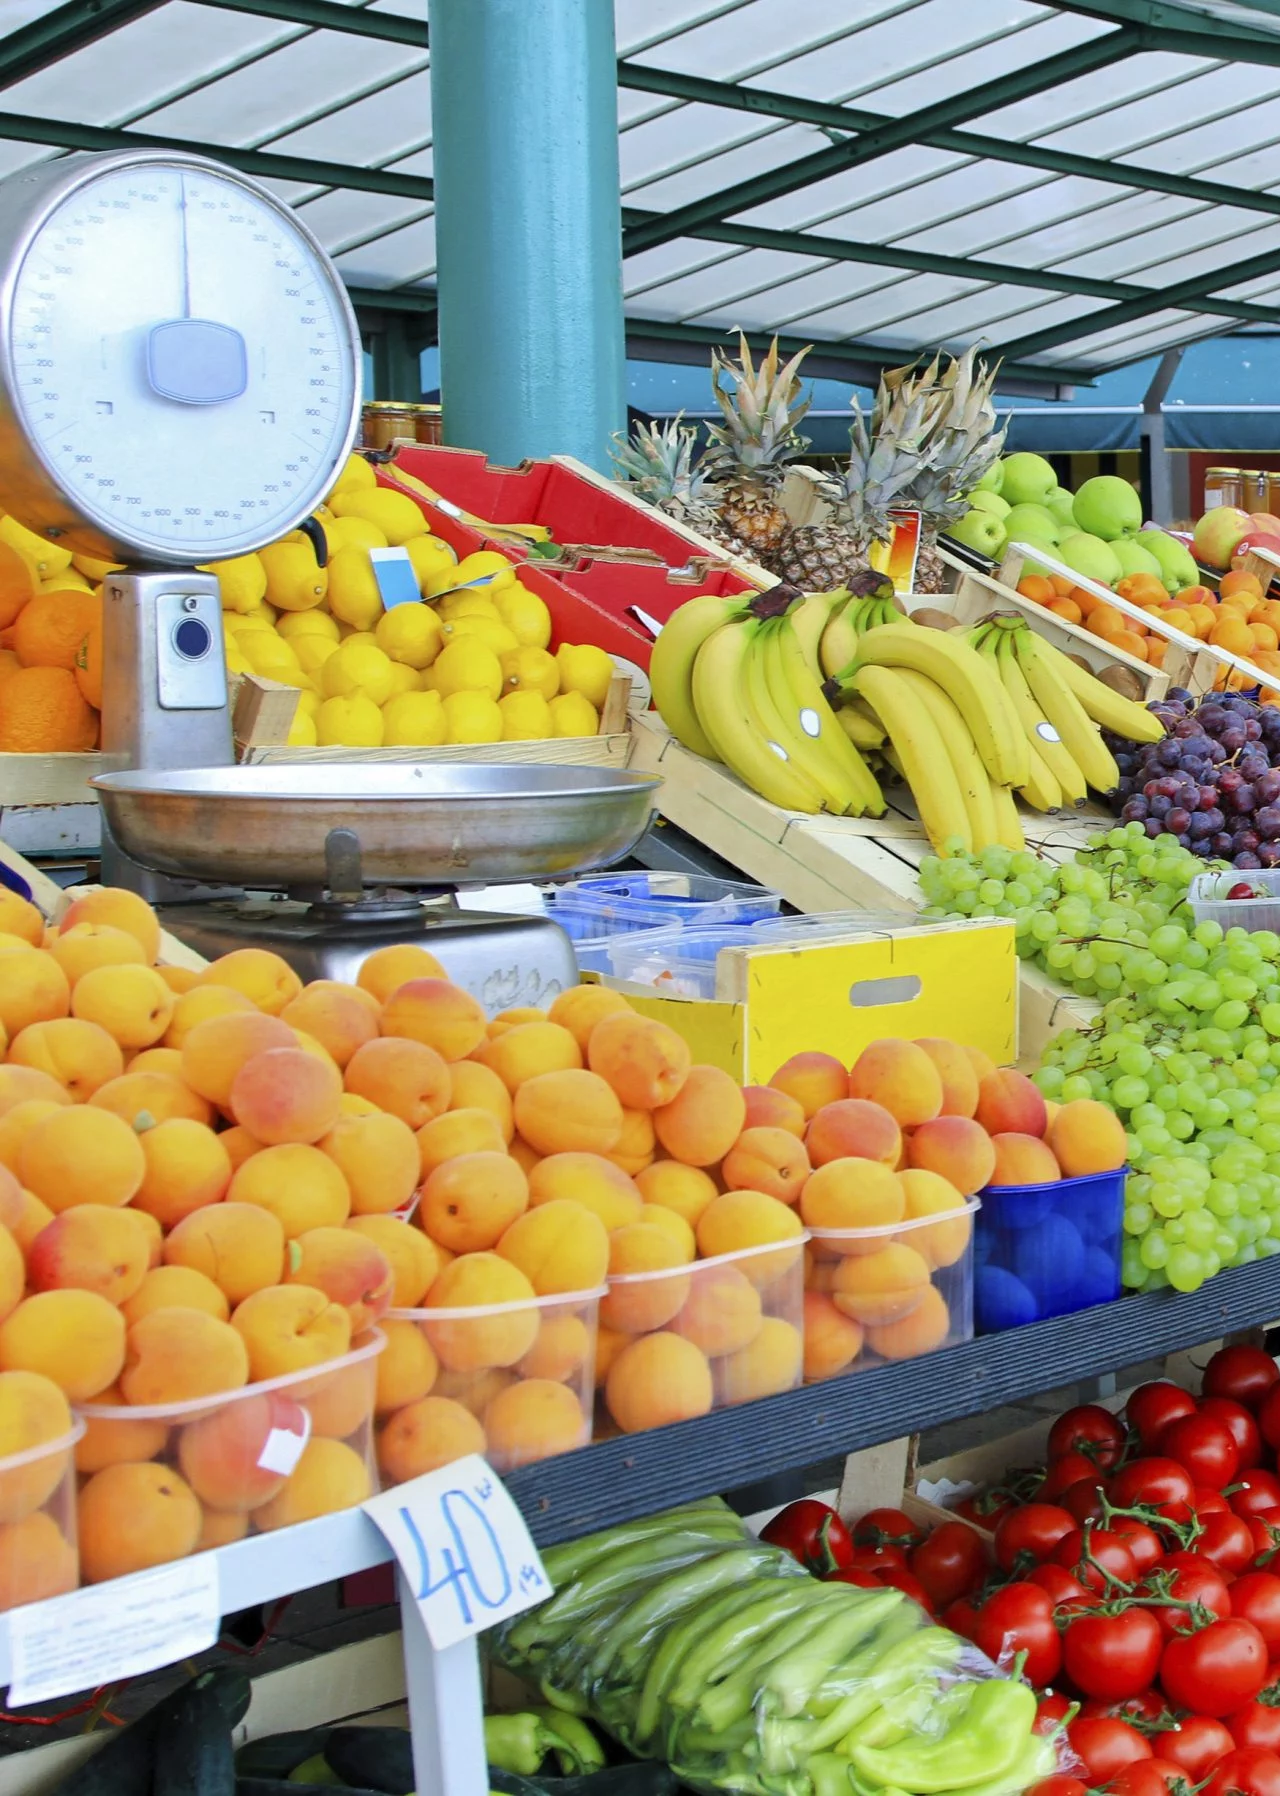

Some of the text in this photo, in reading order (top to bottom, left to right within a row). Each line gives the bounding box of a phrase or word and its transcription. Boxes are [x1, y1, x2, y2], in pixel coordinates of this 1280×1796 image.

[285, 289, 300, 297] 500
[285, 464, 299, 472] 100
[240, 500, 255, 508] 300
[154, 508, 171, 516] 600
[398, 1489, 513, 1625] 40
